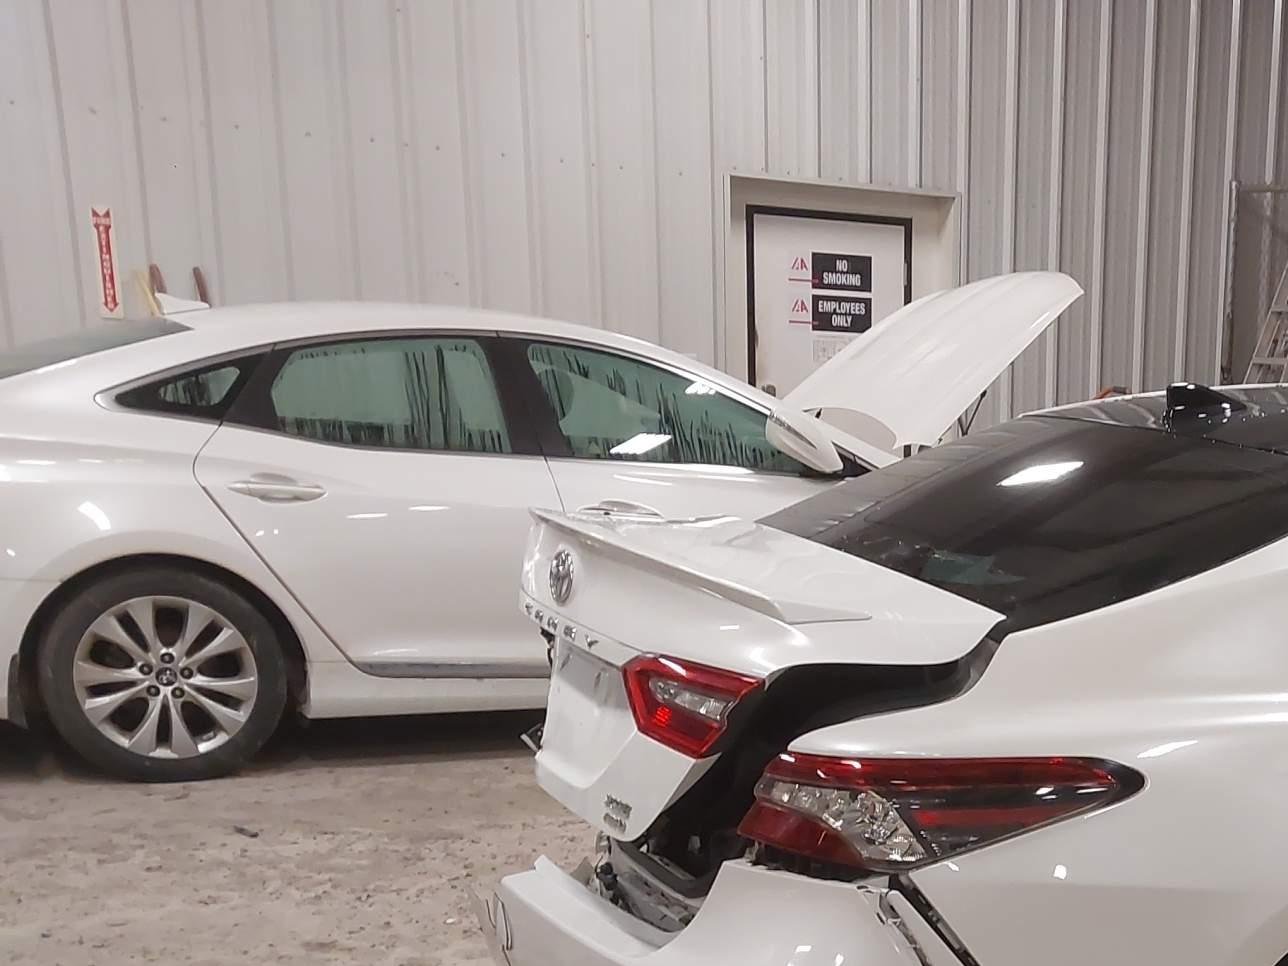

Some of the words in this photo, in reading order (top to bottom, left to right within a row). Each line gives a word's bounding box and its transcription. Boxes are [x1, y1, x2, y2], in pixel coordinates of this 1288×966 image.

[836, 259, 848, 272] NO
[823, 272, 861, 286] SMOKING
[818, 300, 866, 314] EMPLOYEES
[832, 314, 852, 327] ONLY
